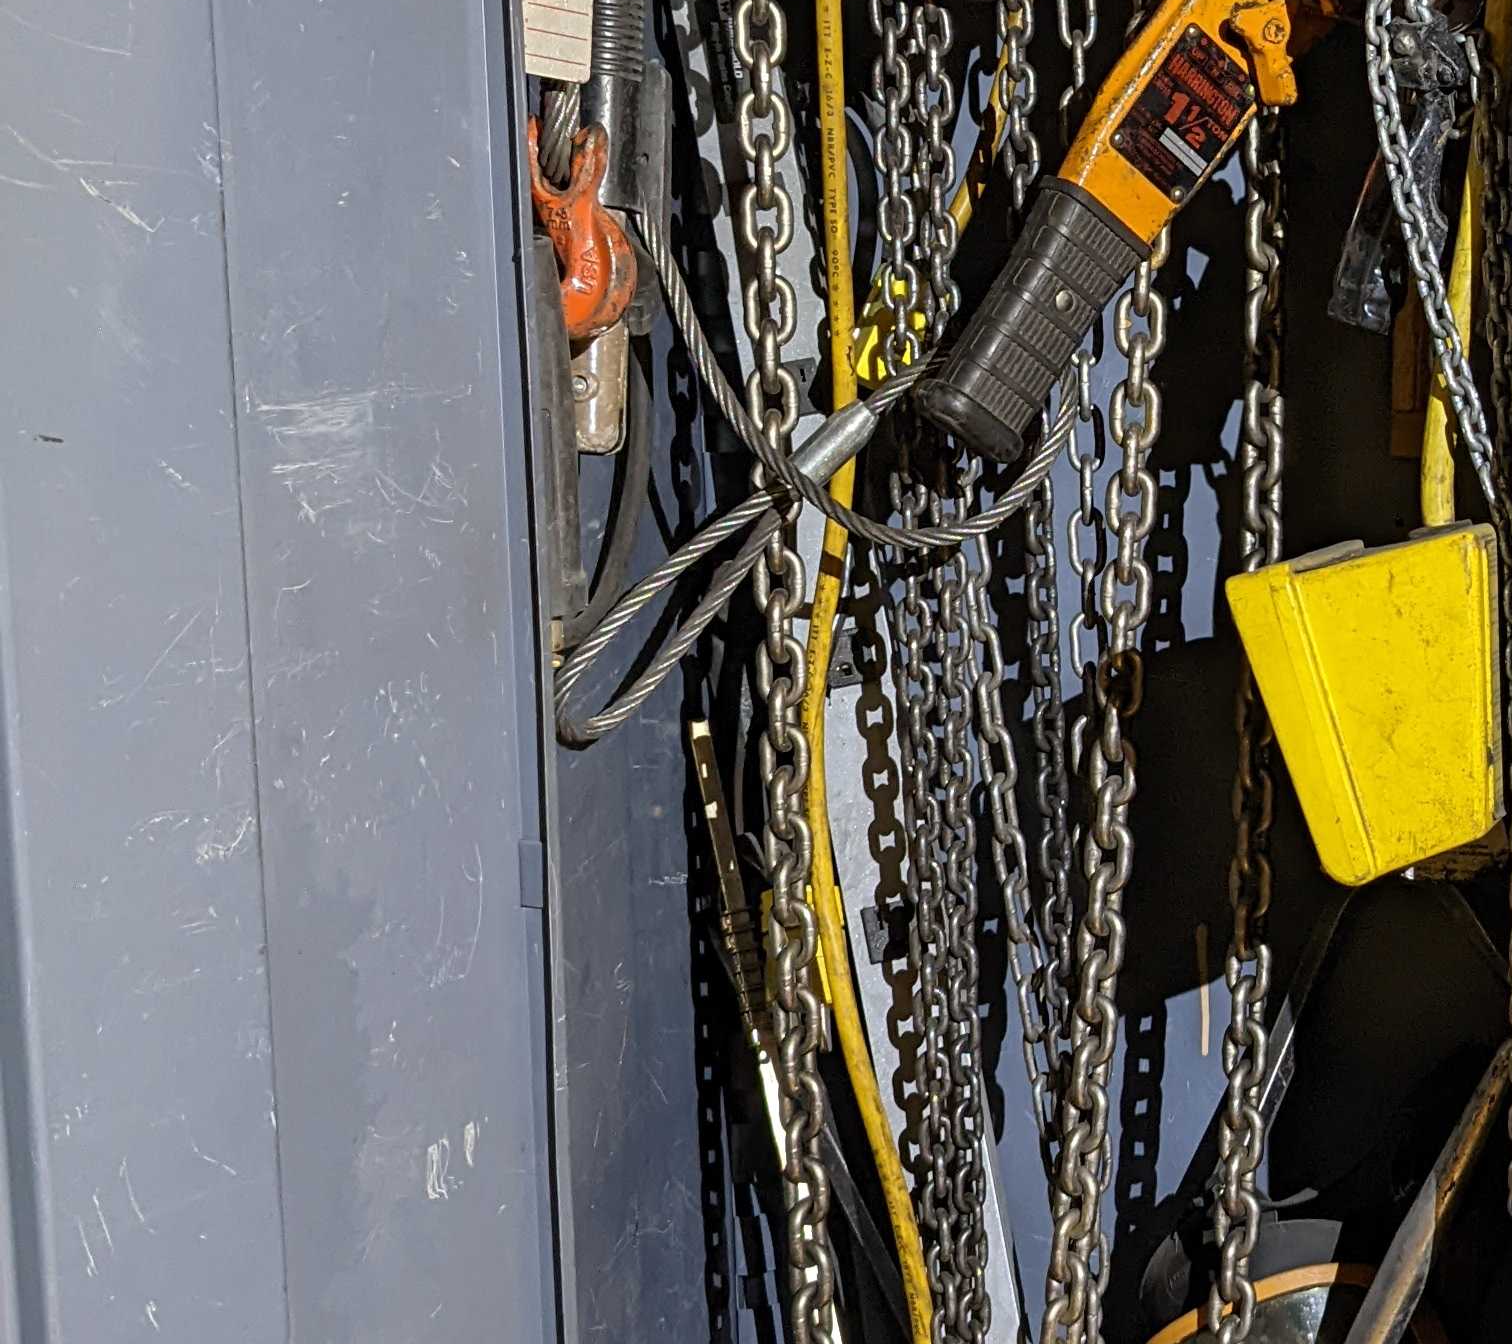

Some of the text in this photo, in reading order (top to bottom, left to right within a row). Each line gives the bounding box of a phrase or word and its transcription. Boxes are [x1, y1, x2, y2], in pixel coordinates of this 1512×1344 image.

[1169, 53, 1241, 129] HARRINGTON
[1207, 118, 1229, 142] TON
[577, 247, 600, 295] USA
